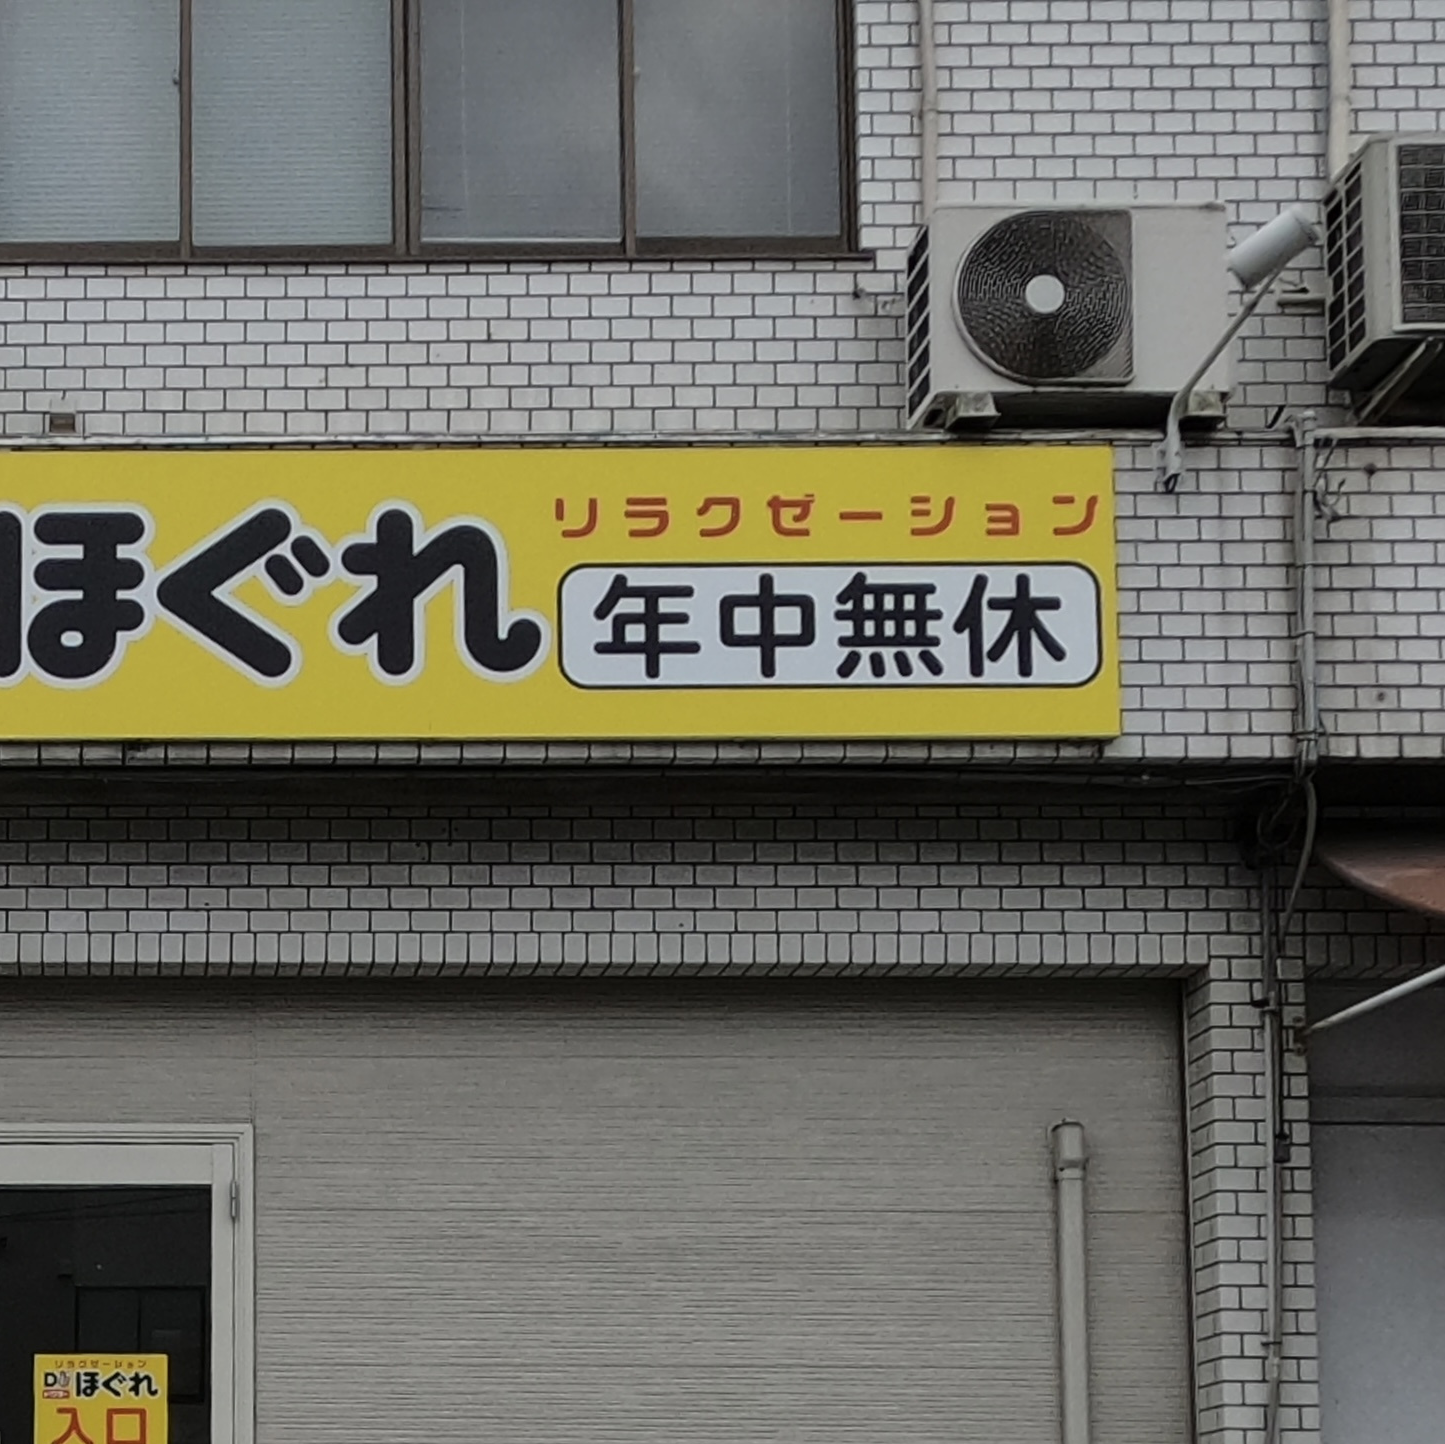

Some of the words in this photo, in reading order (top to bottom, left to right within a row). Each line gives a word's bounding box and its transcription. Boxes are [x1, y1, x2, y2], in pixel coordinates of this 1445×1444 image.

[555, 495, 1099, 539] リラクゼーション
[592, 571, 1067, 680] 年中無休
[75, 1371, 159, 1398] ほぐれ
